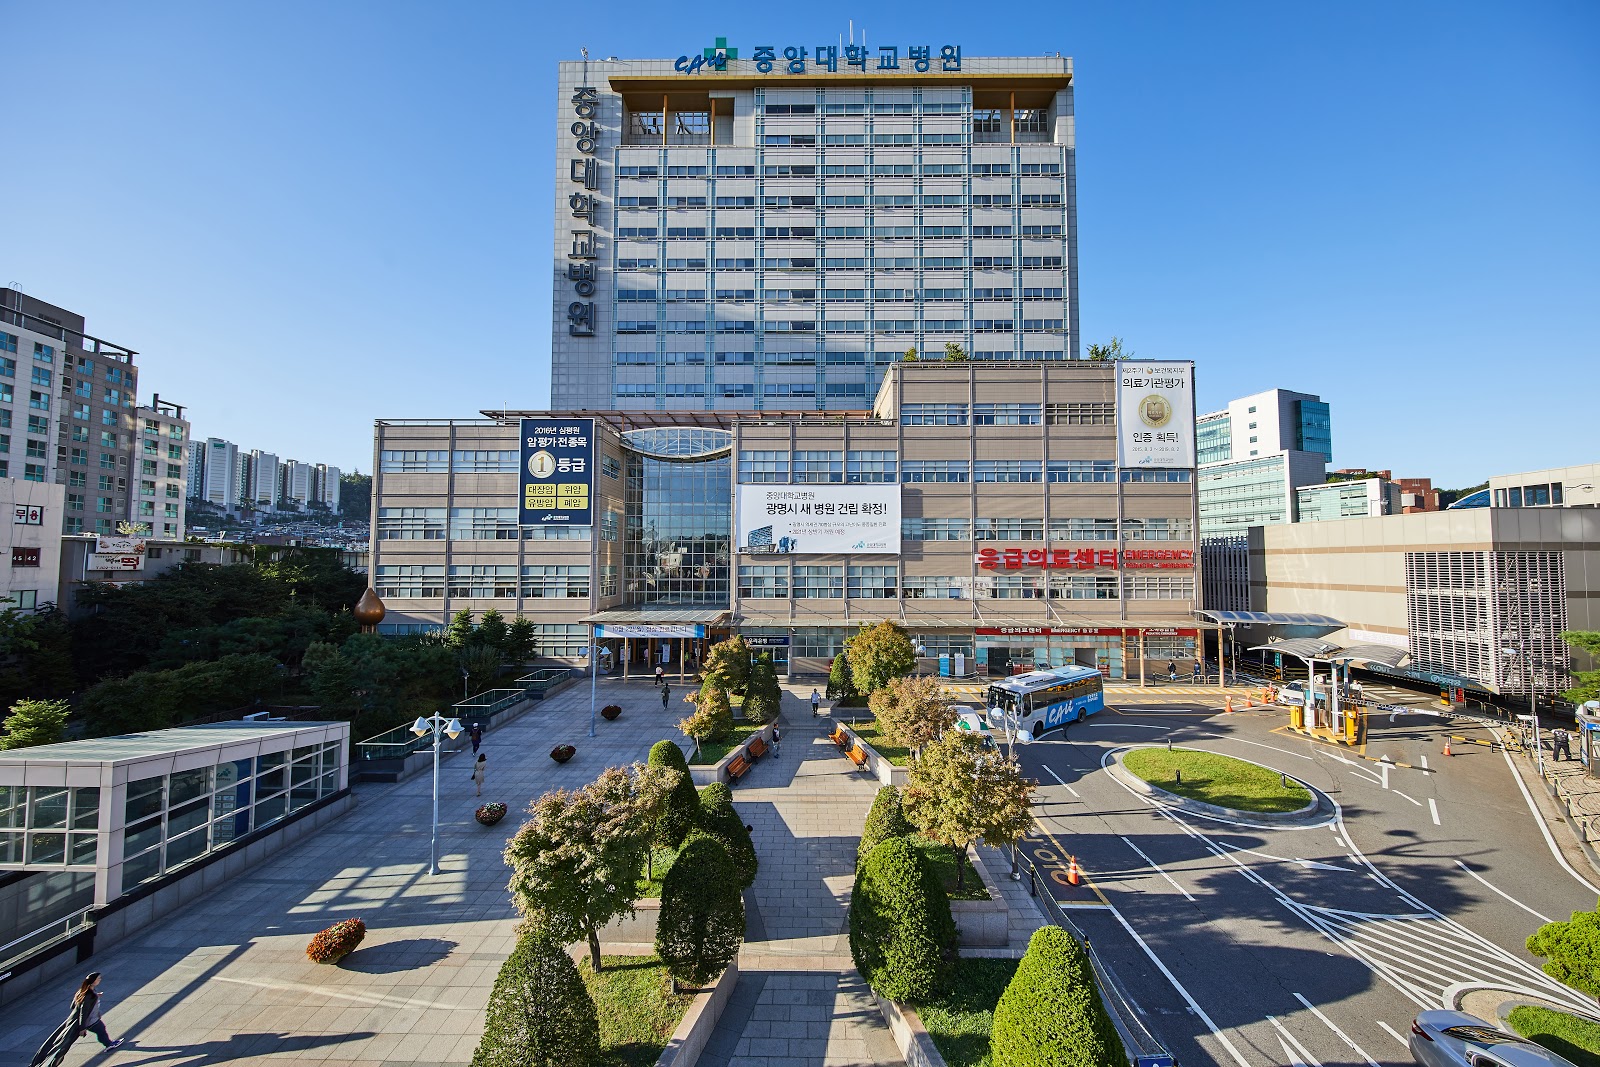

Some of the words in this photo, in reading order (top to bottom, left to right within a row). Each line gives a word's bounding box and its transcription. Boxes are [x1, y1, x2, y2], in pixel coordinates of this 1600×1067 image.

[752, 45, 962, 73] 중앙대학교병원
[567, 87, 599, 336] 중앙대학교병원
[1122, 377, 1185, 389] 의료기관평가
[534, 426, 557, 435] 2016년
[558, 426, 580, 435] 심평원
[527, 436, 557, 448] 암평가
[557, 436, 588, 448] 전종목
[1132, 432, 1153, 443] 인증
[1155, 432, 1179, 443] 획득!
[556, 457, 586, 473] 등급
[528, 485, 554, 495] 대장암
[564, 485, 581, 495] 위암
[766, 491, 815, 500] 중앙대학교병원
[528, 498, 554, 508] 유방암
[766, 503, 798, 515] 광명시
[800, 503, 811, 515] 새
[814, 503, 835, 515] 병원
[837, 503, 859, 515] 건립
[861, 503, 887, 515] 확정!
[978, 547, 1119, 570] 응급의료센터
[1123, 549, 1194, 560] EMERGENCY
[1375, 665, 1391, 673] OUT
